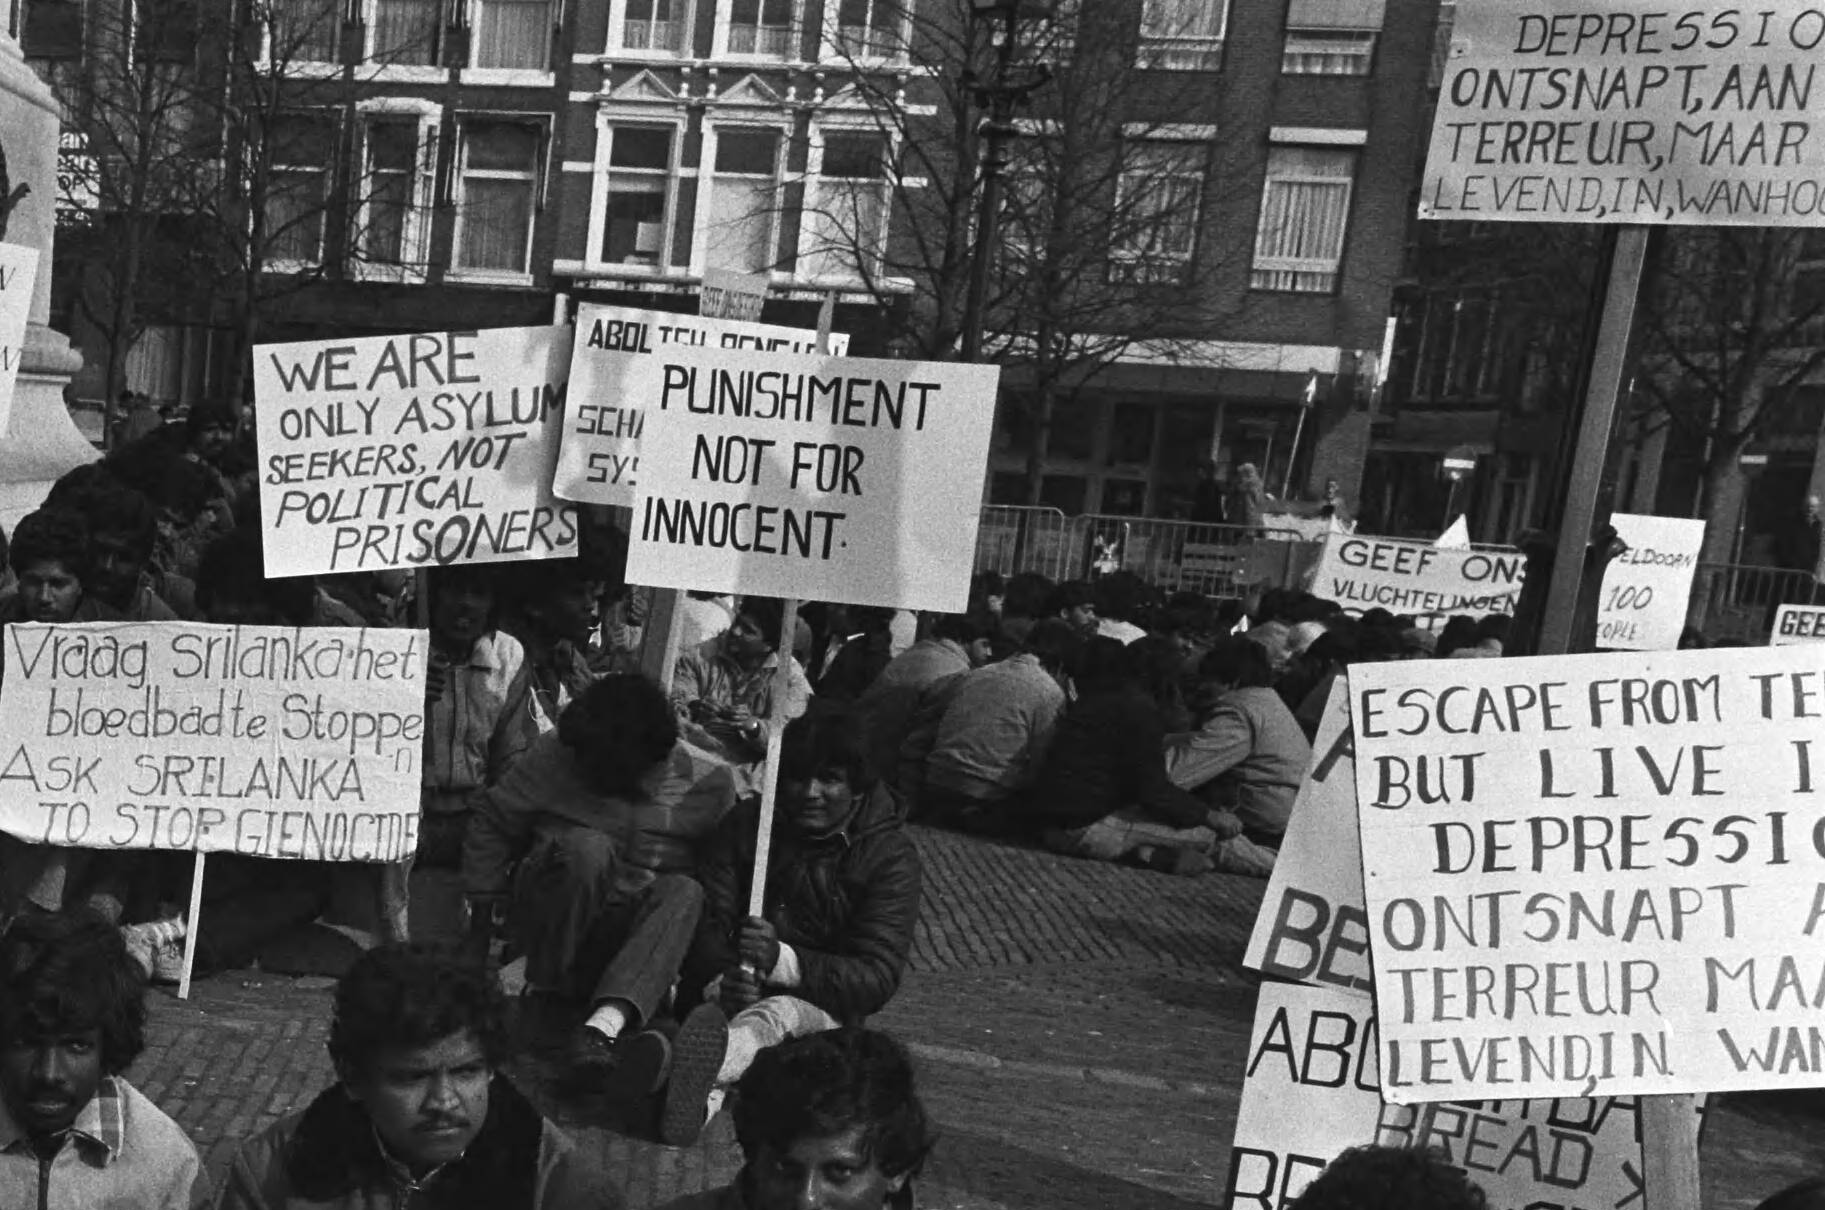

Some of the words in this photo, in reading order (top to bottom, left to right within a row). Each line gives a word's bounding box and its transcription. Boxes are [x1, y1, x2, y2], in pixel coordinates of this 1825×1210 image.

[1710, 63, 1816, 111] AAN
[1668, 120, 1809, 166] MAAR
[270, 344, 358, 393] WE
[366, 332, 481, 393] ARE
[280, 397, 380, 443] ONLY
[393, 381, 567, 436] ASYLUM
[661, 363, 942, 432] PUNISHMENT
[437, 433, 528, 472] NOT
[691, 435, 777, 486] NOT
[789, 441, 865, 497] FOR
[275, 476, 485, 528] POLITICAL
[330, 505, 578, 571] PRISONERS
[1339, 539, 1438, 576] GEEF
[1604, 585, 1653, 613] 100
[10, 624, 148, 689] Vraag
[46, 685, 226, 738] bloedbad
[230, 689, 268, 739] te
[1360, 681, 1572, 740] ESCAPE
[1588, 673, 1722, 730] FROM
[1370, 751, 1488, 809] BUT
[1538, 743, 1726, 800] LIVE
[39, 801, 91, 846] TO
[109, 802, 226, 853] STOP
[1382, 882, 1750, 953] ONTSNAPT
[1385, 957, 1662, 1024] TERREUR
